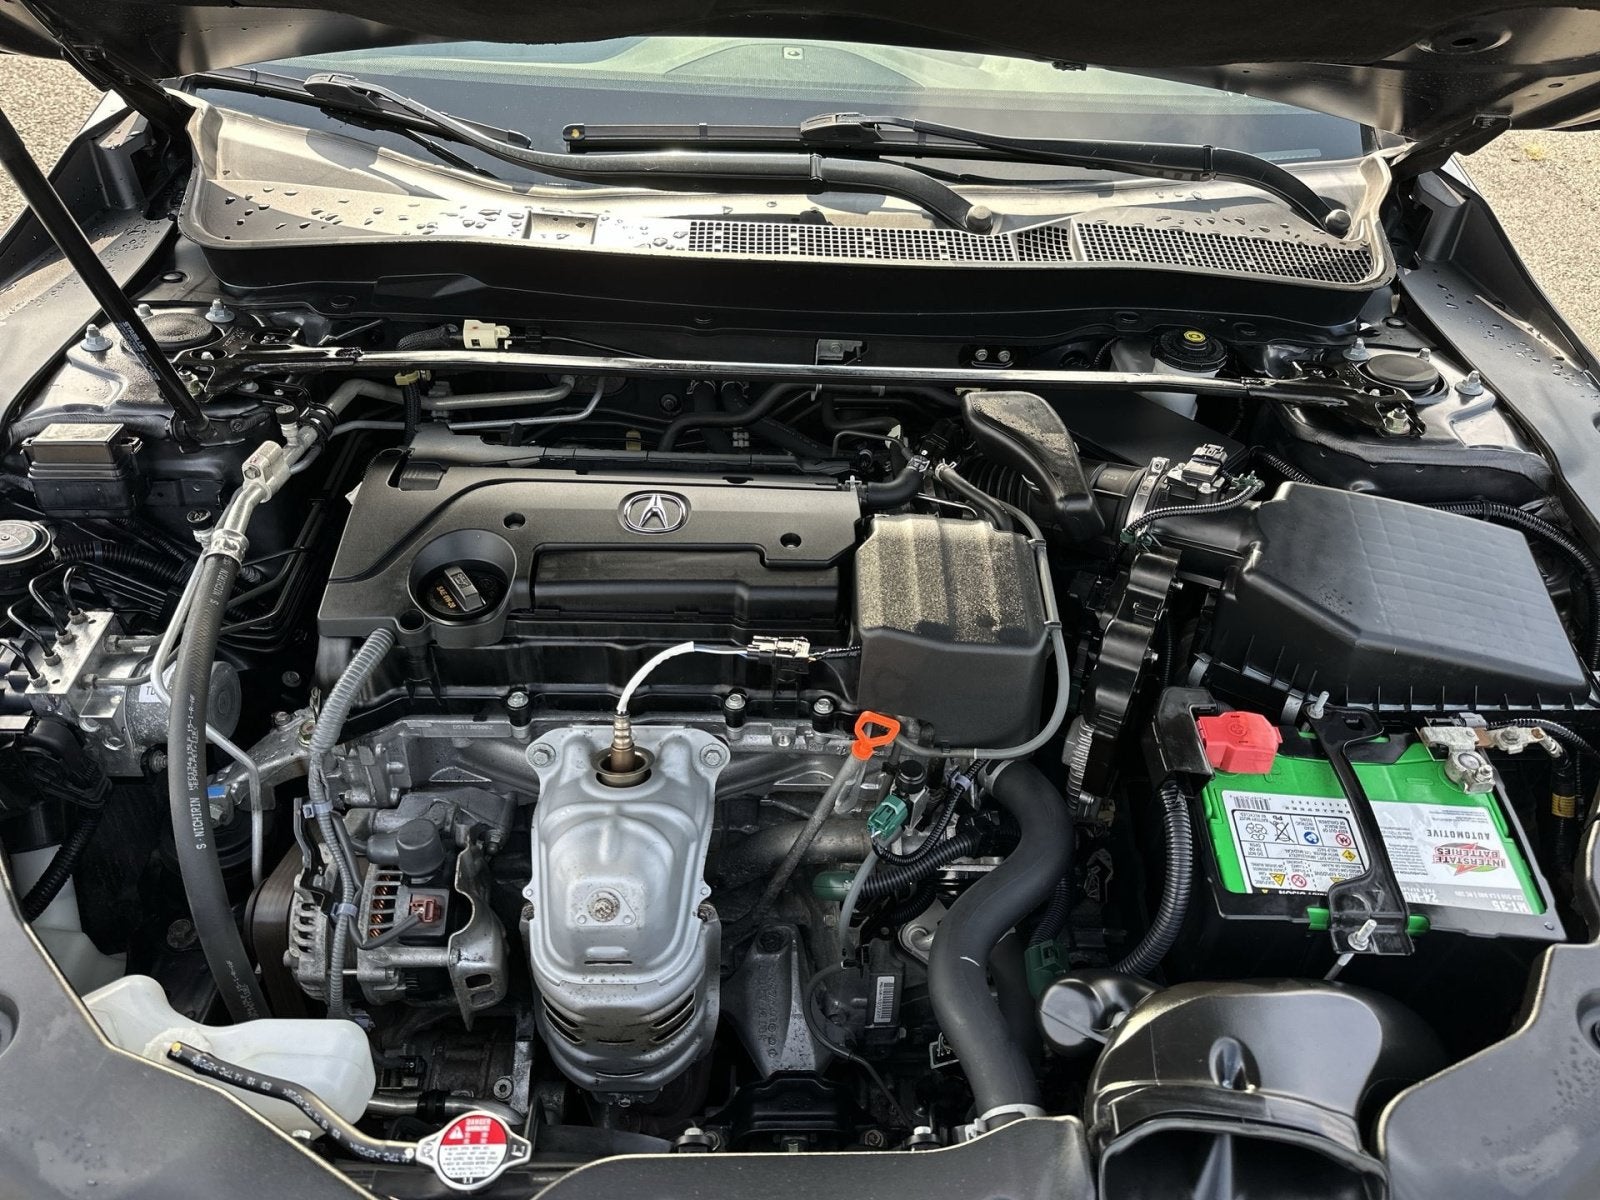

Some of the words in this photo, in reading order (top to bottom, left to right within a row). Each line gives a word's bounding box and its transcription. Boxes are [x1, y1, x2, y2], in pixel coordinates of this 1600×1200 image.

[1427, 829, 1490, 840] AUTOMOTIVE
[1437, 847, 1498, 858] BATTERIES
[1435, 856, 1505, 867] INTERSTATE
[1492, 900, 1528, 912] MT-35
